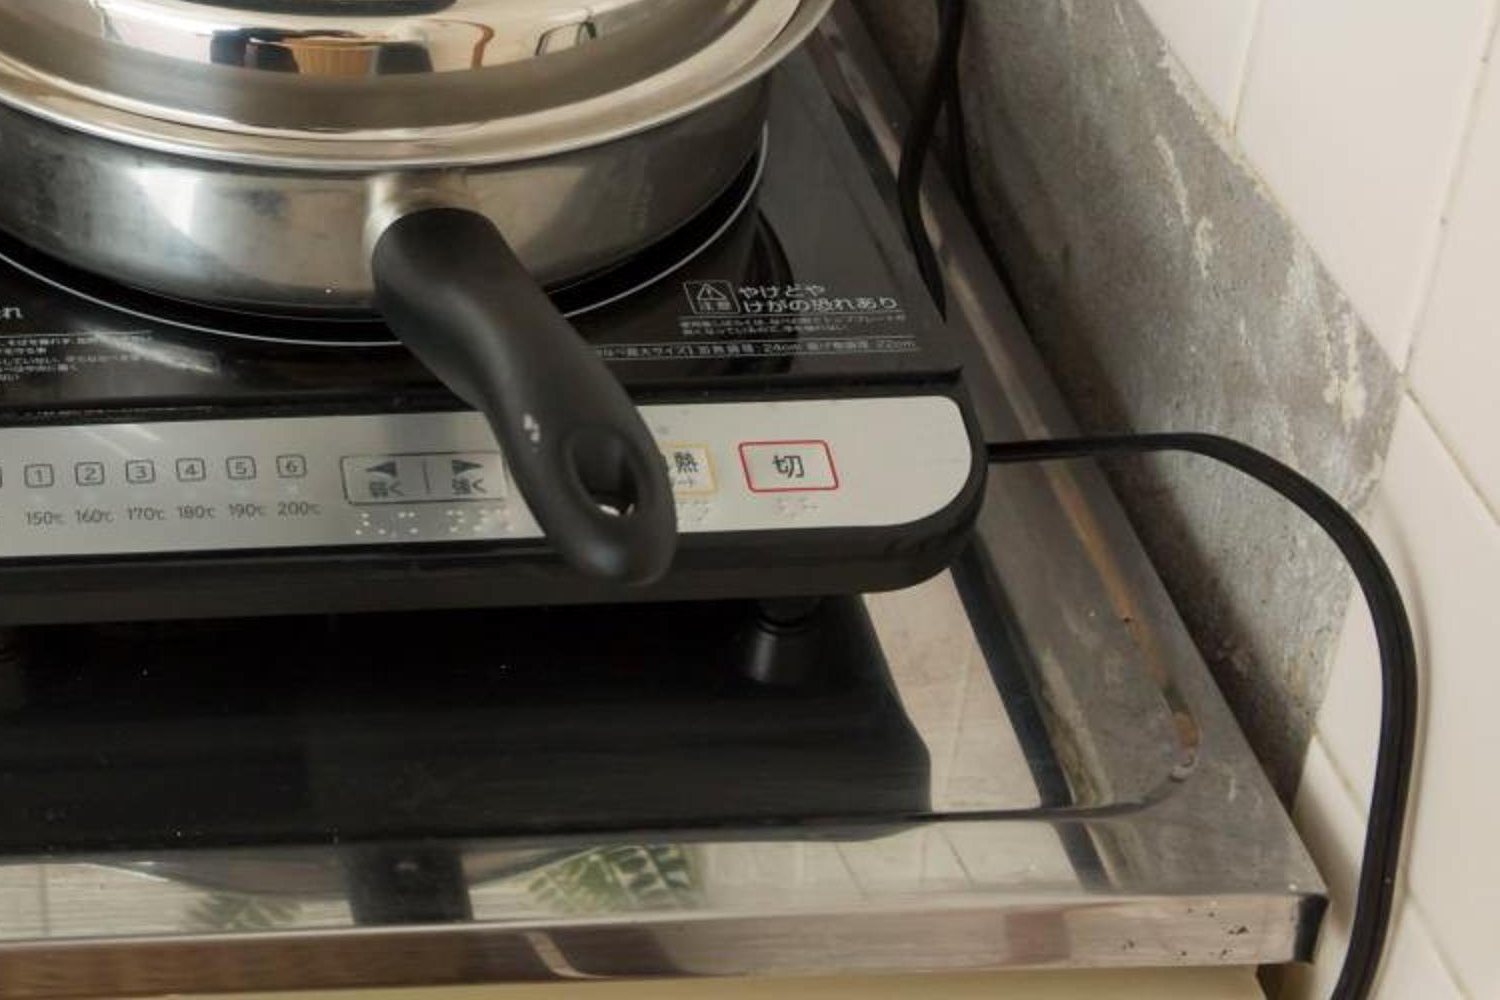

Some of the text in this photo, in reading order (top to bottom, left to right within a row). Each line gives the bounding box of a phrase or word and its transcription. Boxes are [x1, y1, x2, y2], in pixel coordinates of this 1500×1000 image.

[739, 284, 825, 299] やけどや
[34, 468, 44, 483] 1
[84, 466, 97, 481] 2
[134, 465, 147, 479] 3
[185, 463, 197, 476] 4
[235, 461, 248, 475] 5
[286, 459, 298, 473] 6
[666, 452, 698, 474] 熱
[772, 455, 805, 479] 切
